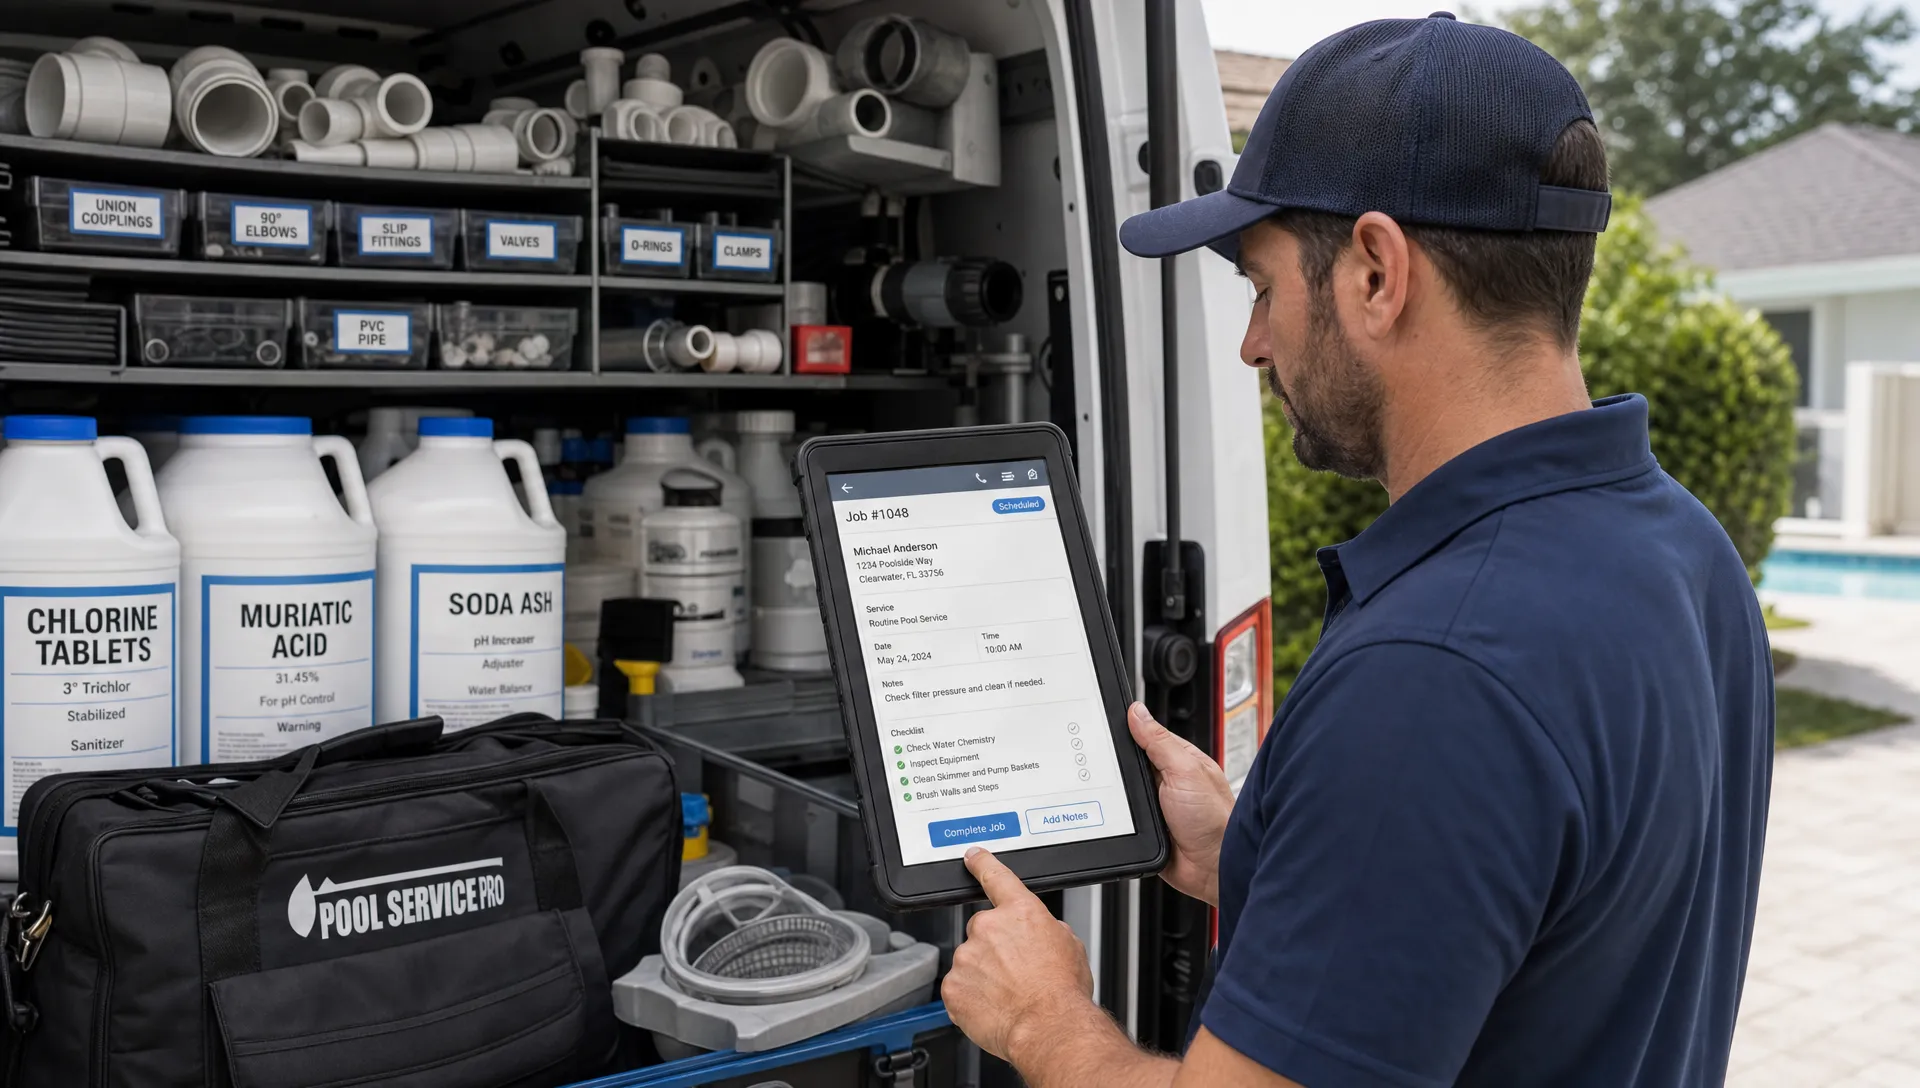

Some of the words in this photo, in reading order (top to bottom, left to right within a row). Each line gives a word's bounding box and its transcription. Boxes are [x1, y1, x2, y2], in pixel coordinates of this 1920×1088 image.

[96, 199, 136, 213] UNION
[81, 212, 153, 228] COUPLINGS
[245, 225, 298, 239] ELBOWS
[382, 223, 408, 234] SLIP
[371, 235, 421, 248] FITTINGS
[500, 234, 540, 248] VALVES
[631, 239, 673, 253] O-RINGS
[723, 245, 762, 259] CLAMPS
[360, 320, 385, 332] PVC
[358, 333, 386, 346] PIPE
[999, 500, 1040, 512] Scheduled
[845, 510, 868, 523] Job
[871, 507, 910, 520] #1048
[853, 544, 891, 557] Michael
[893, 542, 938, 554] Anderson
[856, 561, 877, 570] 1234
[879, 558, 914, 569] Poolside
[915, 557, 934, 567] Way
[858, 572, 906, 584] Clearwater,
[907, 571, 917, 580] FL
[918, 569, 944, 579] 33756
[449, 592, 514, 616] SODA
[520, 591, 553, 614] ASH
[866, 603, 895, 614] Service
[27, 605, 158, 635] CHLORINE
[241, 600, 353, 629] MURIATIC
[868, 617, 899, 628] Routine
[900, 615, 918, 625] Pool
[919, 613, 948, 624] Service
[474, 636, 489, 648] pH
[492, 635, 535, 646] Increaser
[981, 632, 1000, 641] Time
[35, 636, 152, 666] TABLETS
[272, 632, 327, 659] ACID
[874, 642, 892, 651] Date
[985, 644, 1007, 654] 10:00
[1009, 643, 1022, 651] AM
[482, 659, 525, 671] Adjuster
[877, 656, 895, 666] May
[896, 654, 910, 663] 24,
[911, 652, 932, 662] 2024
[275, 671, 320, 685] 31.45%
[882, 679, 904, 689] Notes
[82, 680, 131, 694] Trichlor
[468, 685, 497, 695] Water
[885, 691, 911, 703] Check
[912, 689, 930, 699] filter
[932, 687, 967, 699] pressure
[968, 684, 983, 694] and
[985, 681, 1006, 692] clean
[1007, 680, 1013, 689] if
[1014, 677, 1046, 688] needed.
[260, 695, 278, 707] For
[281, 695, 297, 709] pH
[299, 692, 335, 706] Control
[67, 707, 126, 722] Stabilized
[277, 720, 322, 733] Warning
[890, 727, 924, 737] Checklist
[70, 738, 125, 752] Sanitizer
[906, 742, 931, 753] Check
[932, 740, 955, 751] Water
[957, 735, 996, 748] Chemistry
[909, 758, 938, 769] Inspect
[939, 753, 980, 766] Equipment
[913, 774, 936, 785] Clean
[937, 771, 970, 782] Skimmer
[972, 768, 986, 778] and
[987, 766, 1009, 777] Pump
[1011, 761, 1039, 772] Baskets
[916, 790, 939, 801] Brush
[940, 787, 961, 797] Walls
[962, 785, 977, 795] and
[978, 783, 999, 794] Steps
[1042, 814, 1061, 825] Add
[1062, 811, 1088, 823] Notes
[944, 824, 987, 839] Complete
[988, 822, 1006, 834] Job
[319, 893, 383, 940] POOL
[387, 877, 479, 928] SERVICE
[479, 874, 505, 910] PRO
